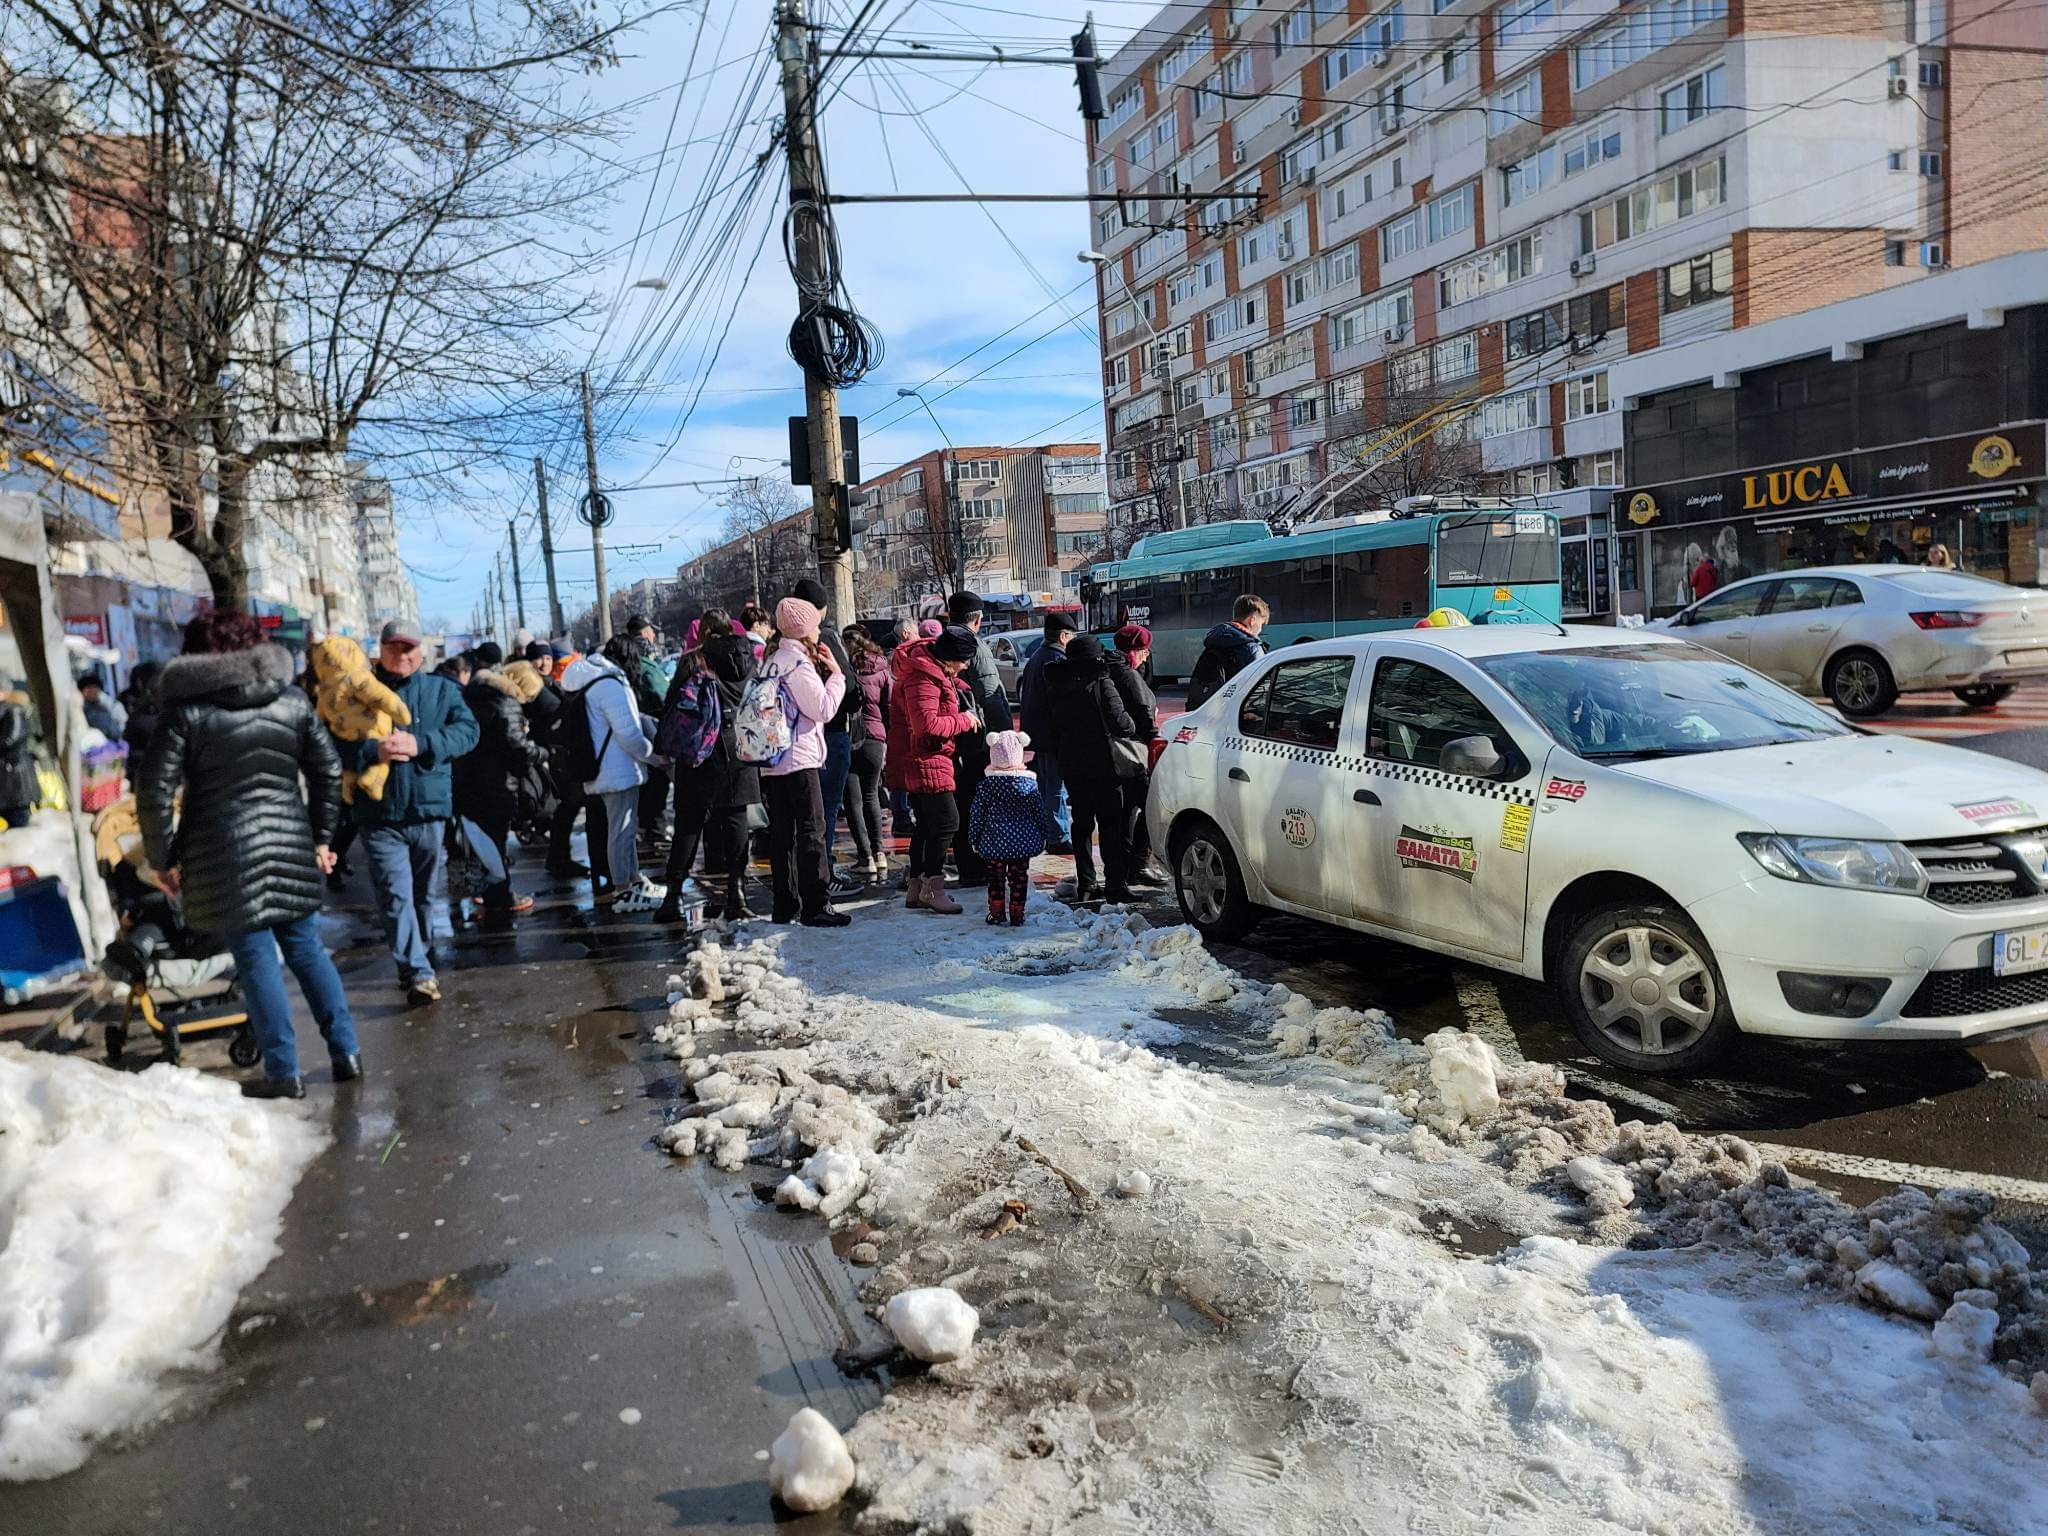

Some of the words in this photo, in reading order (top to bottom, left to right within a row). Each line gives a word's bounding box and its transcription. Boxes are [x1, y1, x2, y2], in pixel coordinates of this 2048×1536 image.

[1743, 463, 1852, 509] LUCA
[1546, 781, 1587, 798] 946
[1288, 820, 1306, 836] 213
[2006, 935, 2033, 963] GL
